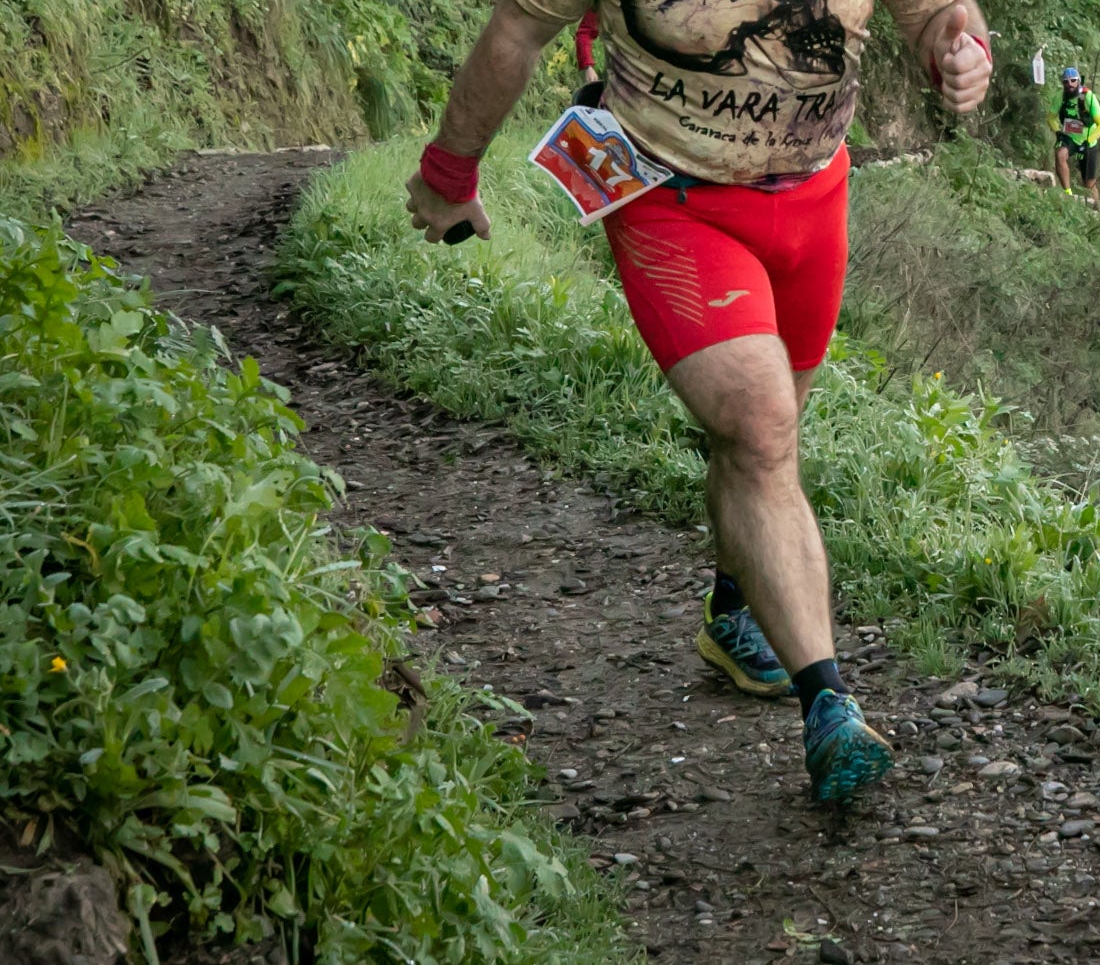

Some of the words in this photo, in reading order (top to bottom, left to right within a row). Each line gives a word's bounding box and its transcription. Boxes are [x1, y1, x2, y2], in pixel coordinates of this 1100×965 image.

[648, 71, 686, 107] LA
[702, 89, 780, 122] VARA
[742, 131, 760, 146] de
[765, 131, 776, 146] la
[588, 146, 633, 188] 17
